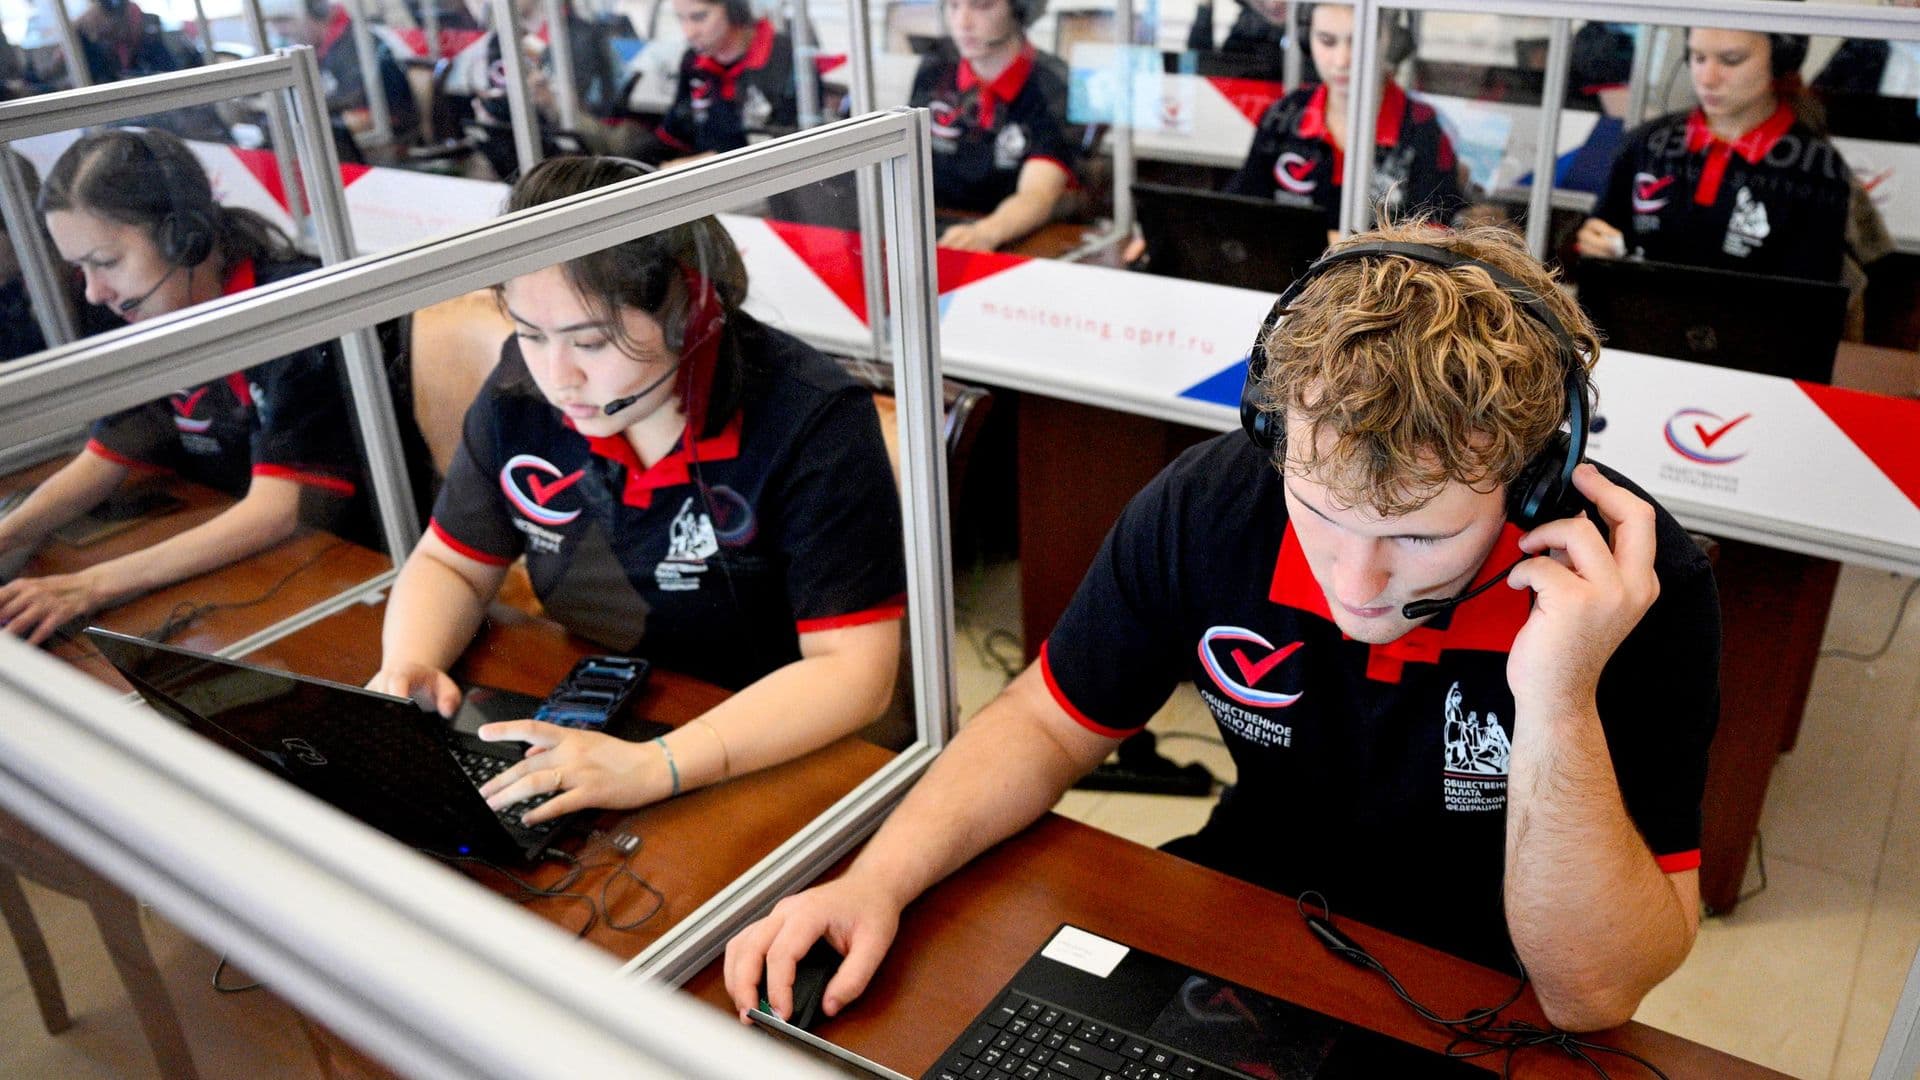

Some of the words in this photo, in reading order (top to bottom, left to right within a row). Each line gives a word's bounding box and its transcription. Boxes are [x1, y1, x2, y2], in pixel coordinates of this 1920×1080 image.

[1201, 689, 1292, 737] ОБЩЕСТВЕННОЕ
[1444, 787, 1482, 797] ПАЛАТА
[1445, 795, 1506, 804] РОССИЙСКОЙ
[1446, 803, 1502, 811] ФЕДЕРАЦИИ
